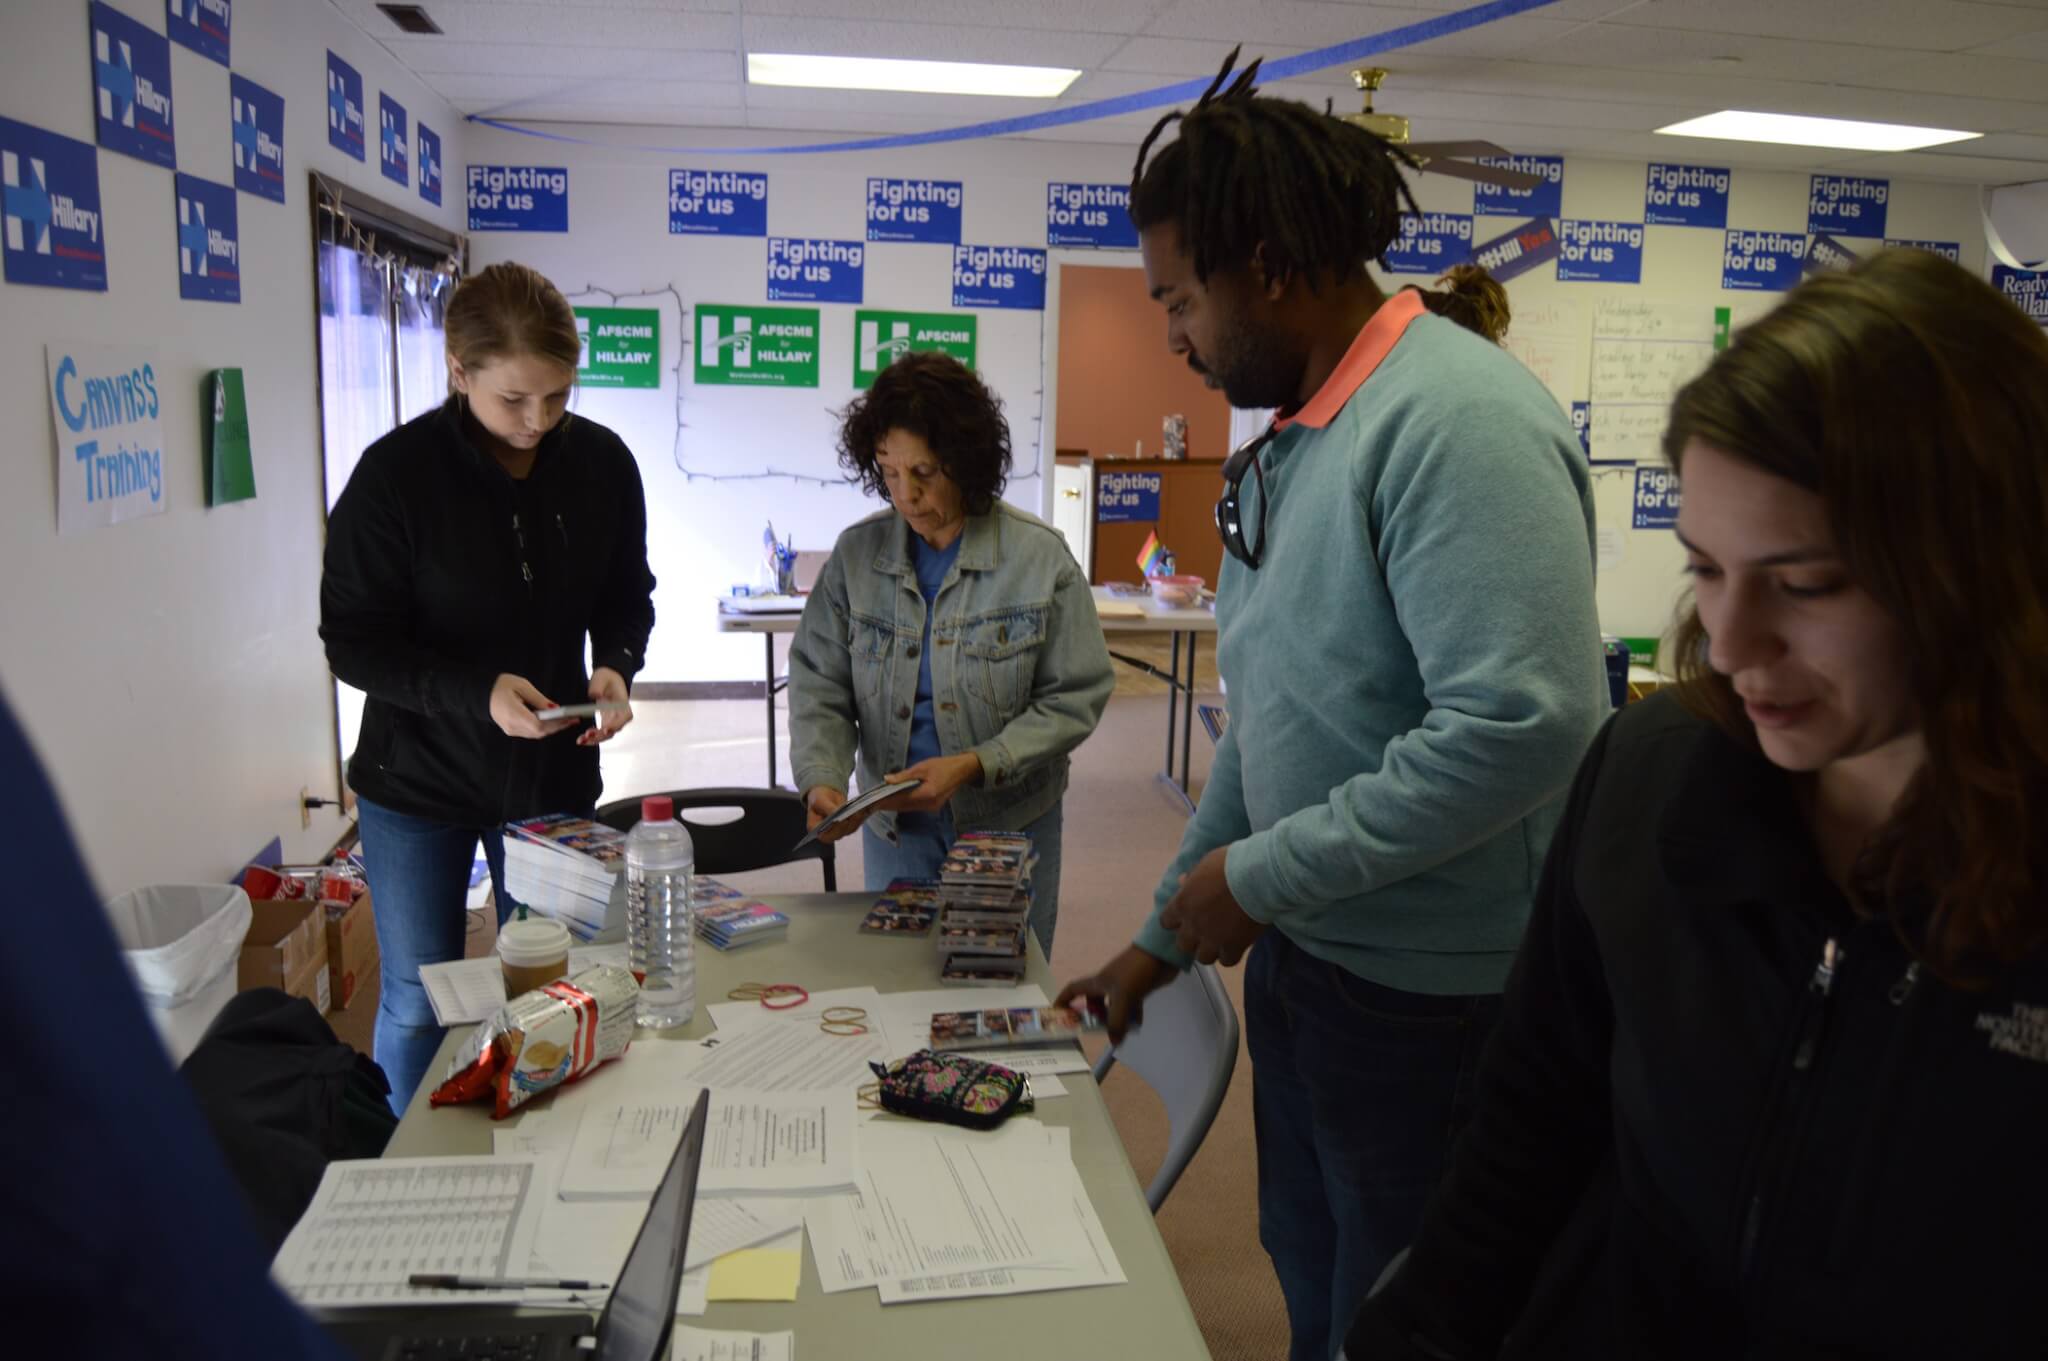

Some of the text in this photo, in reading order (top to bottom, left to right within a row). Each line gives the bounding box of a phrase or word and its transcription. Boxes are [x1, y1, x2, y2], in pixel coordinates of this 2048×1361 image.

[136, 74, 170, 126] Hillary
[256, 128, 281, 169] Hillary
[468, 167, 566, 195] Fighting
[670, 171, 767, 200] Fighting
[1647, 166, 1729, 194] Fighting
[1811, 177, 1888, 204] Fighting
[468, 188, 534, 210] for us
[669, 193, 735, 215] for us
[868, 180, 962, 208] Fighting
[1049, 185, 1132, 209] Fighting
[1646, 185, 1700, 208] for us
[51, 192, 98, 243] Hillary
[866, 201, 930, 223] for us
[1048, 205, 1109, 227] for us
[1809, 197, 1861, 218] for us
[1399, 213, 1472, 240] ighting
[1560, 222, 1643, 248] Fighting
[207, 228, 237, 265] Hillary
[769, 239, 863, 268] Fighting
[1418, 238, 1442, 254] us
[1590, 246, 1614, 263] us
[1726, 231, 1805, 258] Fighting
[768, 260, 831, 282] for us
[955, 246, 1046, 274] Fighting
[1724, 251, 1776, 272] for us
[953, 267, 1016, 289] for us
[2002, 273, 2048, 297] Ready
[597, 325, 653, 338] AFSCME
[758, 324, 813, 337] AFSCME
[916, 330, 970, 343] AFSCME
[596, 351, 653, 363] HILLARY
[757, 350, 813, 363] HILLARY
[1099, 473, 1160, 492] Fighting
[1638, 472, 1681, 494] Figh
[1099, 490, 1140, 506] for us
[1636, 490, 1666, 507] for
